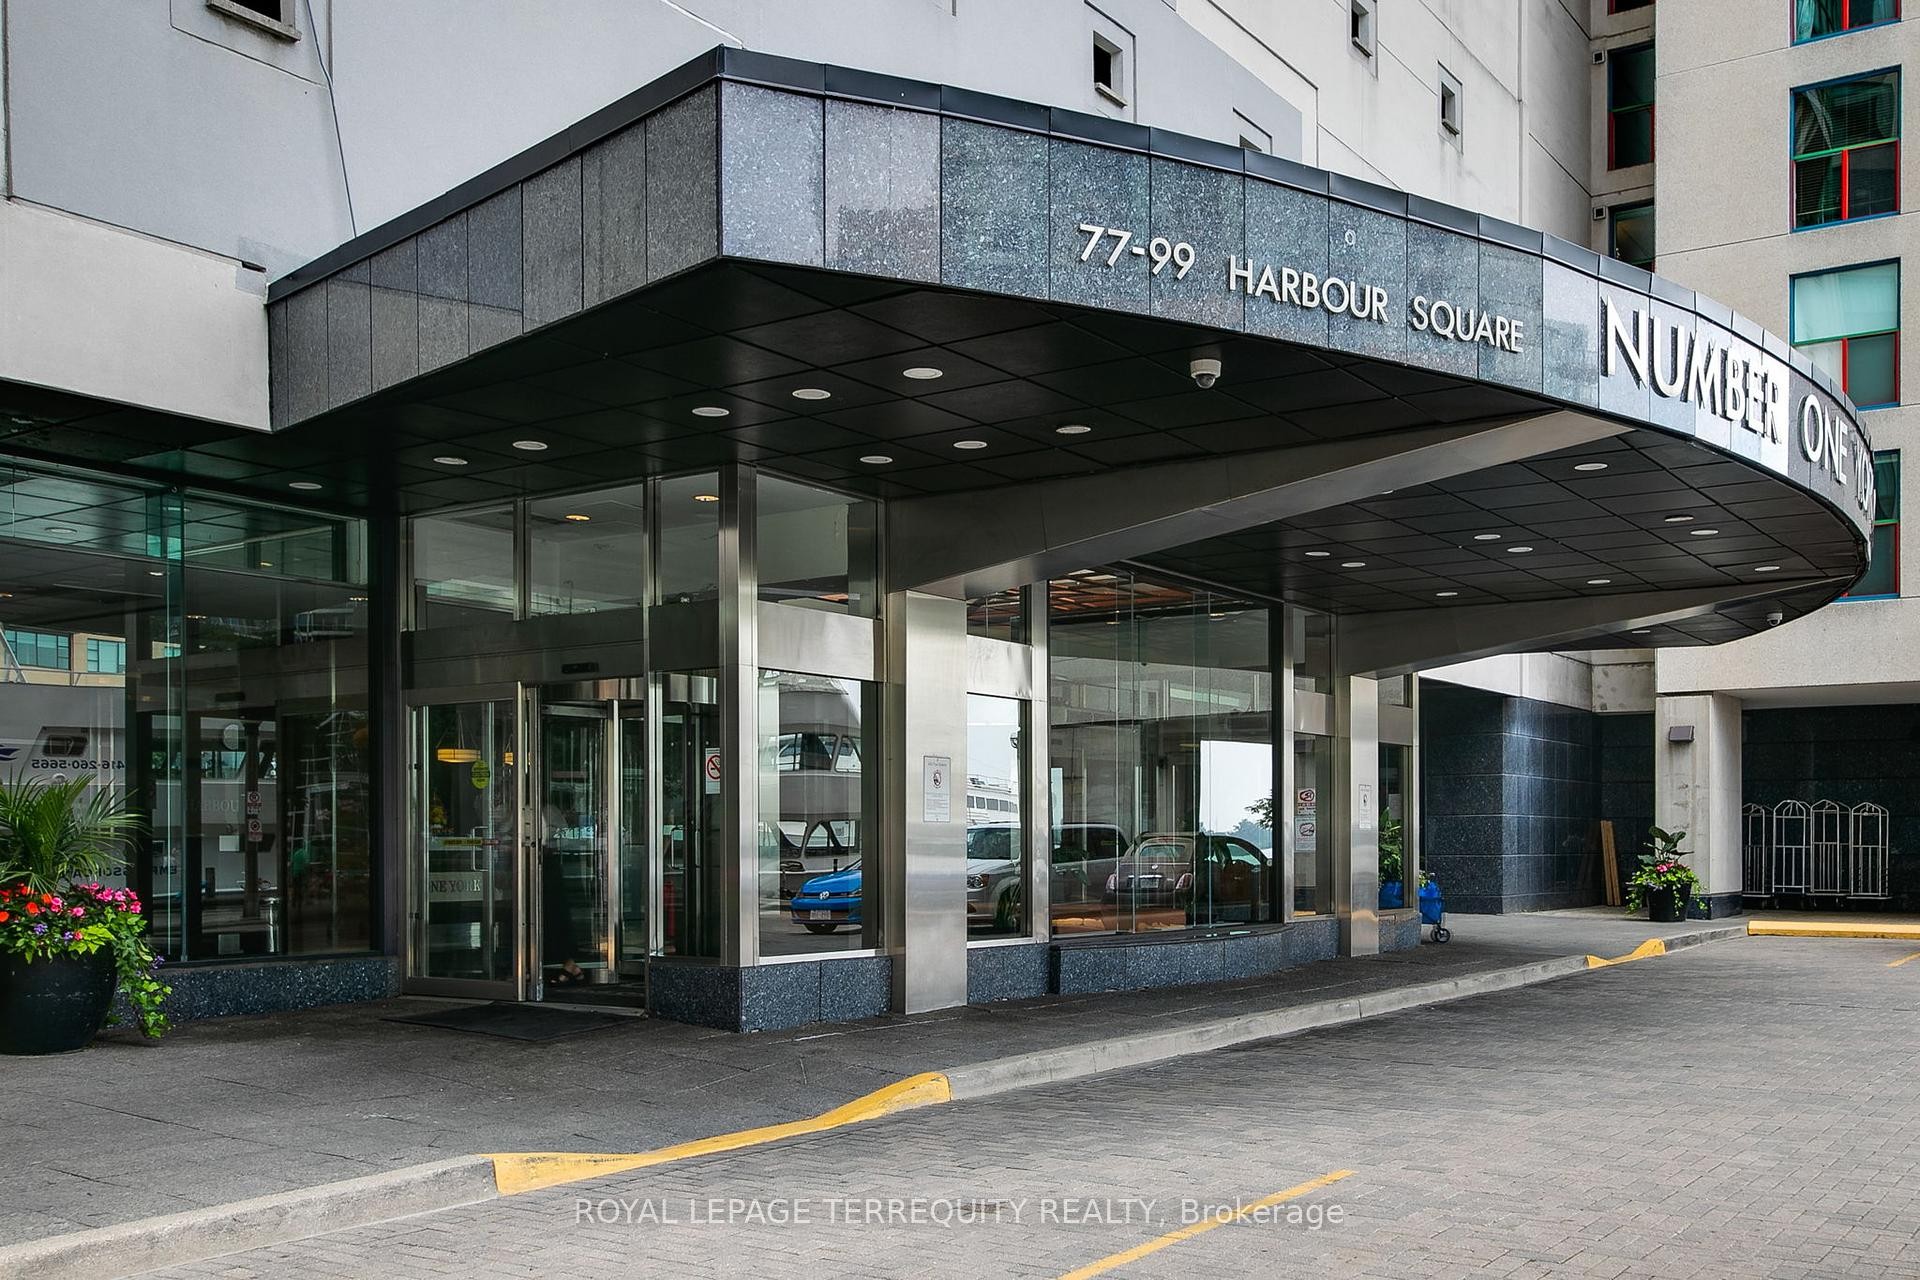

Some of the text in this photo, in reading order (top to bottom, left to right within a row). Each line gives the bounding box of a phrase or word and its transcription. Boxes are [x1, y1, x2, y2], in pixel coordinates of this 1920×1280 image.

[1079, 223, 1524, 353] 77-99 HARBOUR SQUARE
[1601, 294, 1783, 445] NUMBER
[1800, 394, 1848, 486] ONE
